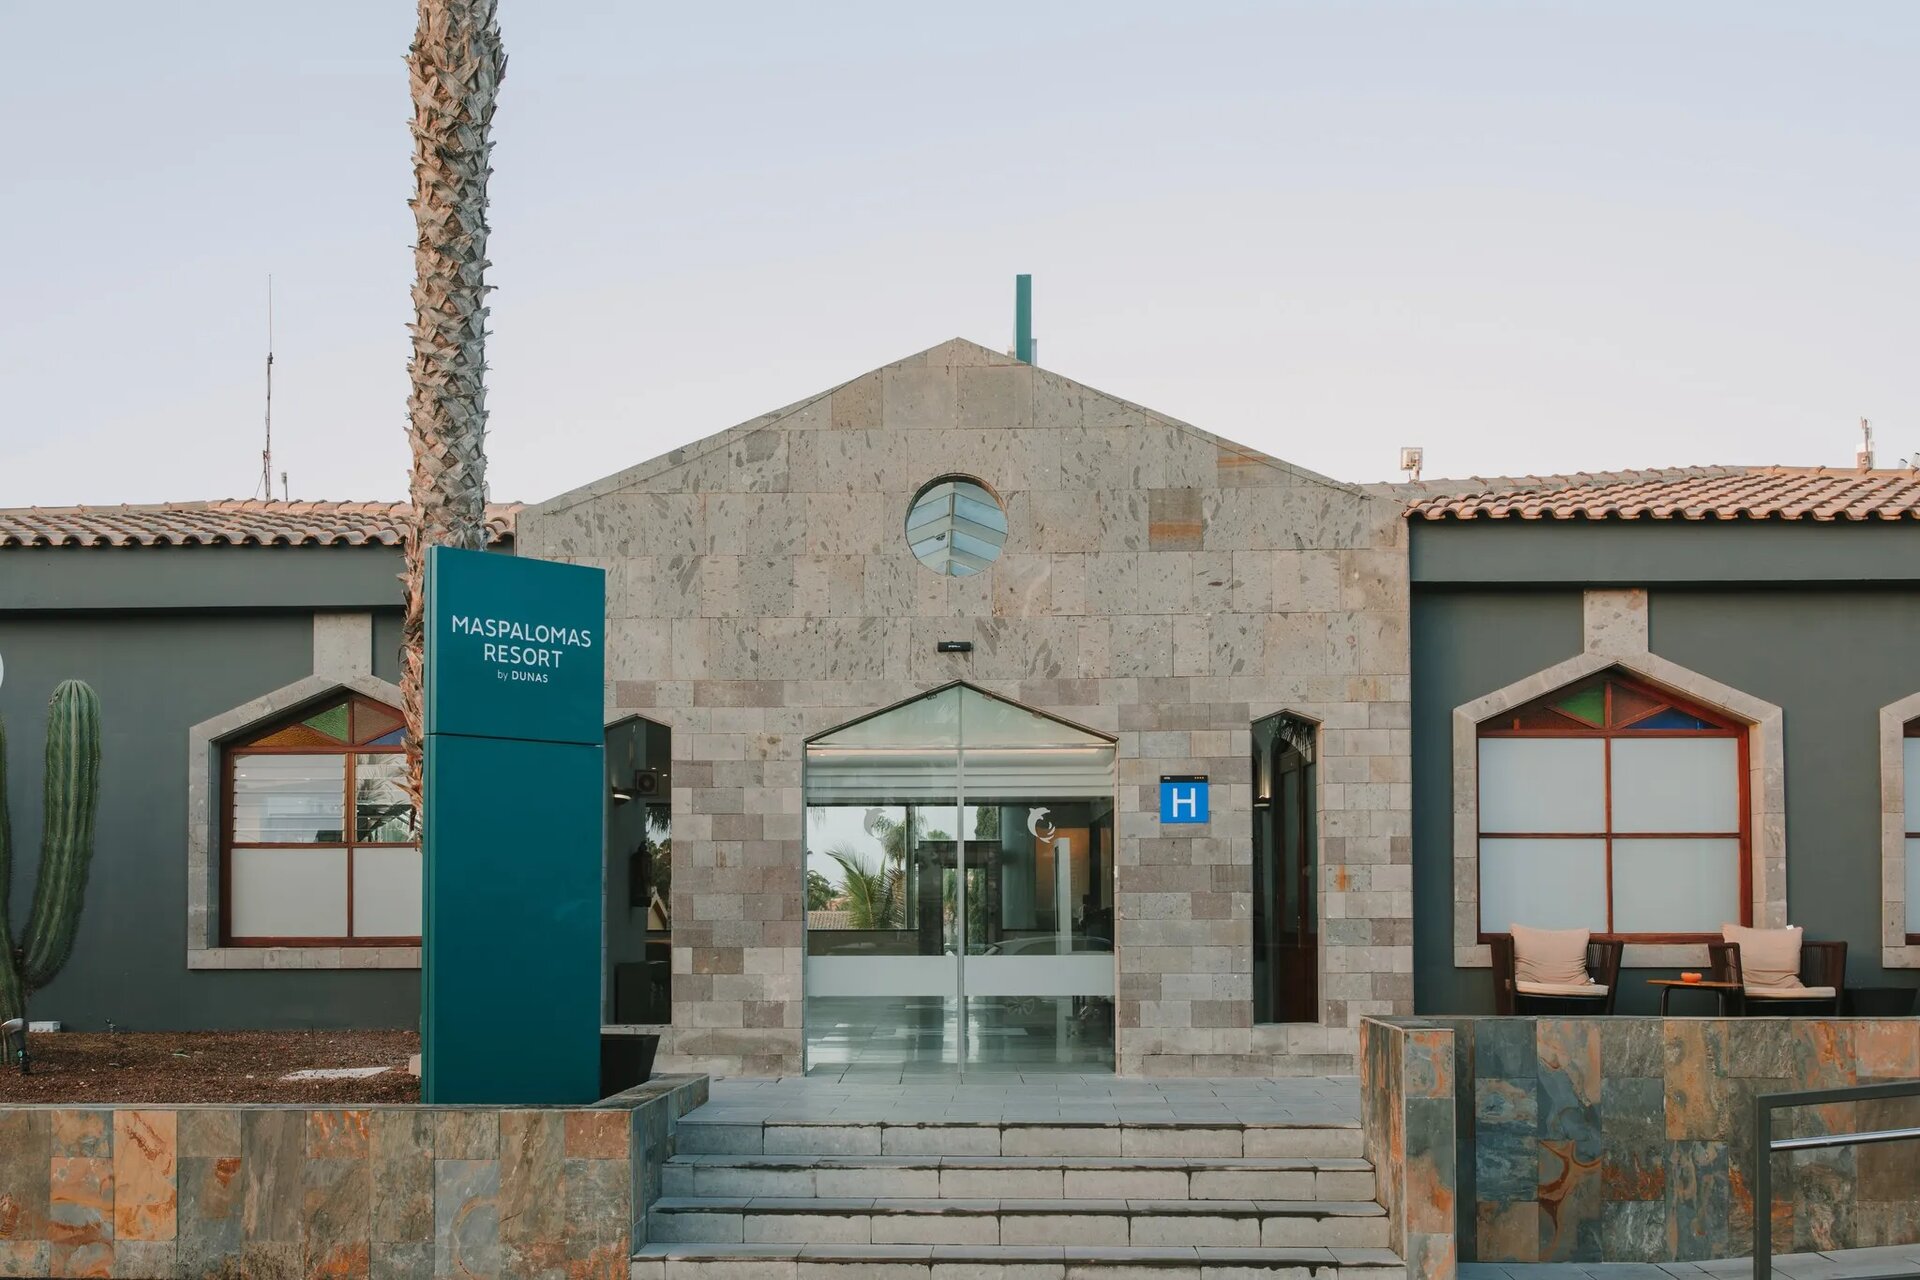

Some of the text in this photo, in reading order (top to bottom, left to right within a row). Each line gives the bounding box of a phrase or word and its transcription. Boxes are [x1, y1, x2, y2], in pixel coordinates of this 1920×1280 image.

[452, 615, 592, 648] MASPALOMAS
[484, 643, 563, 668] RESORT
[497, 670, 549, 683] by DUNAS
[1172, 787, 1196, 818] H
